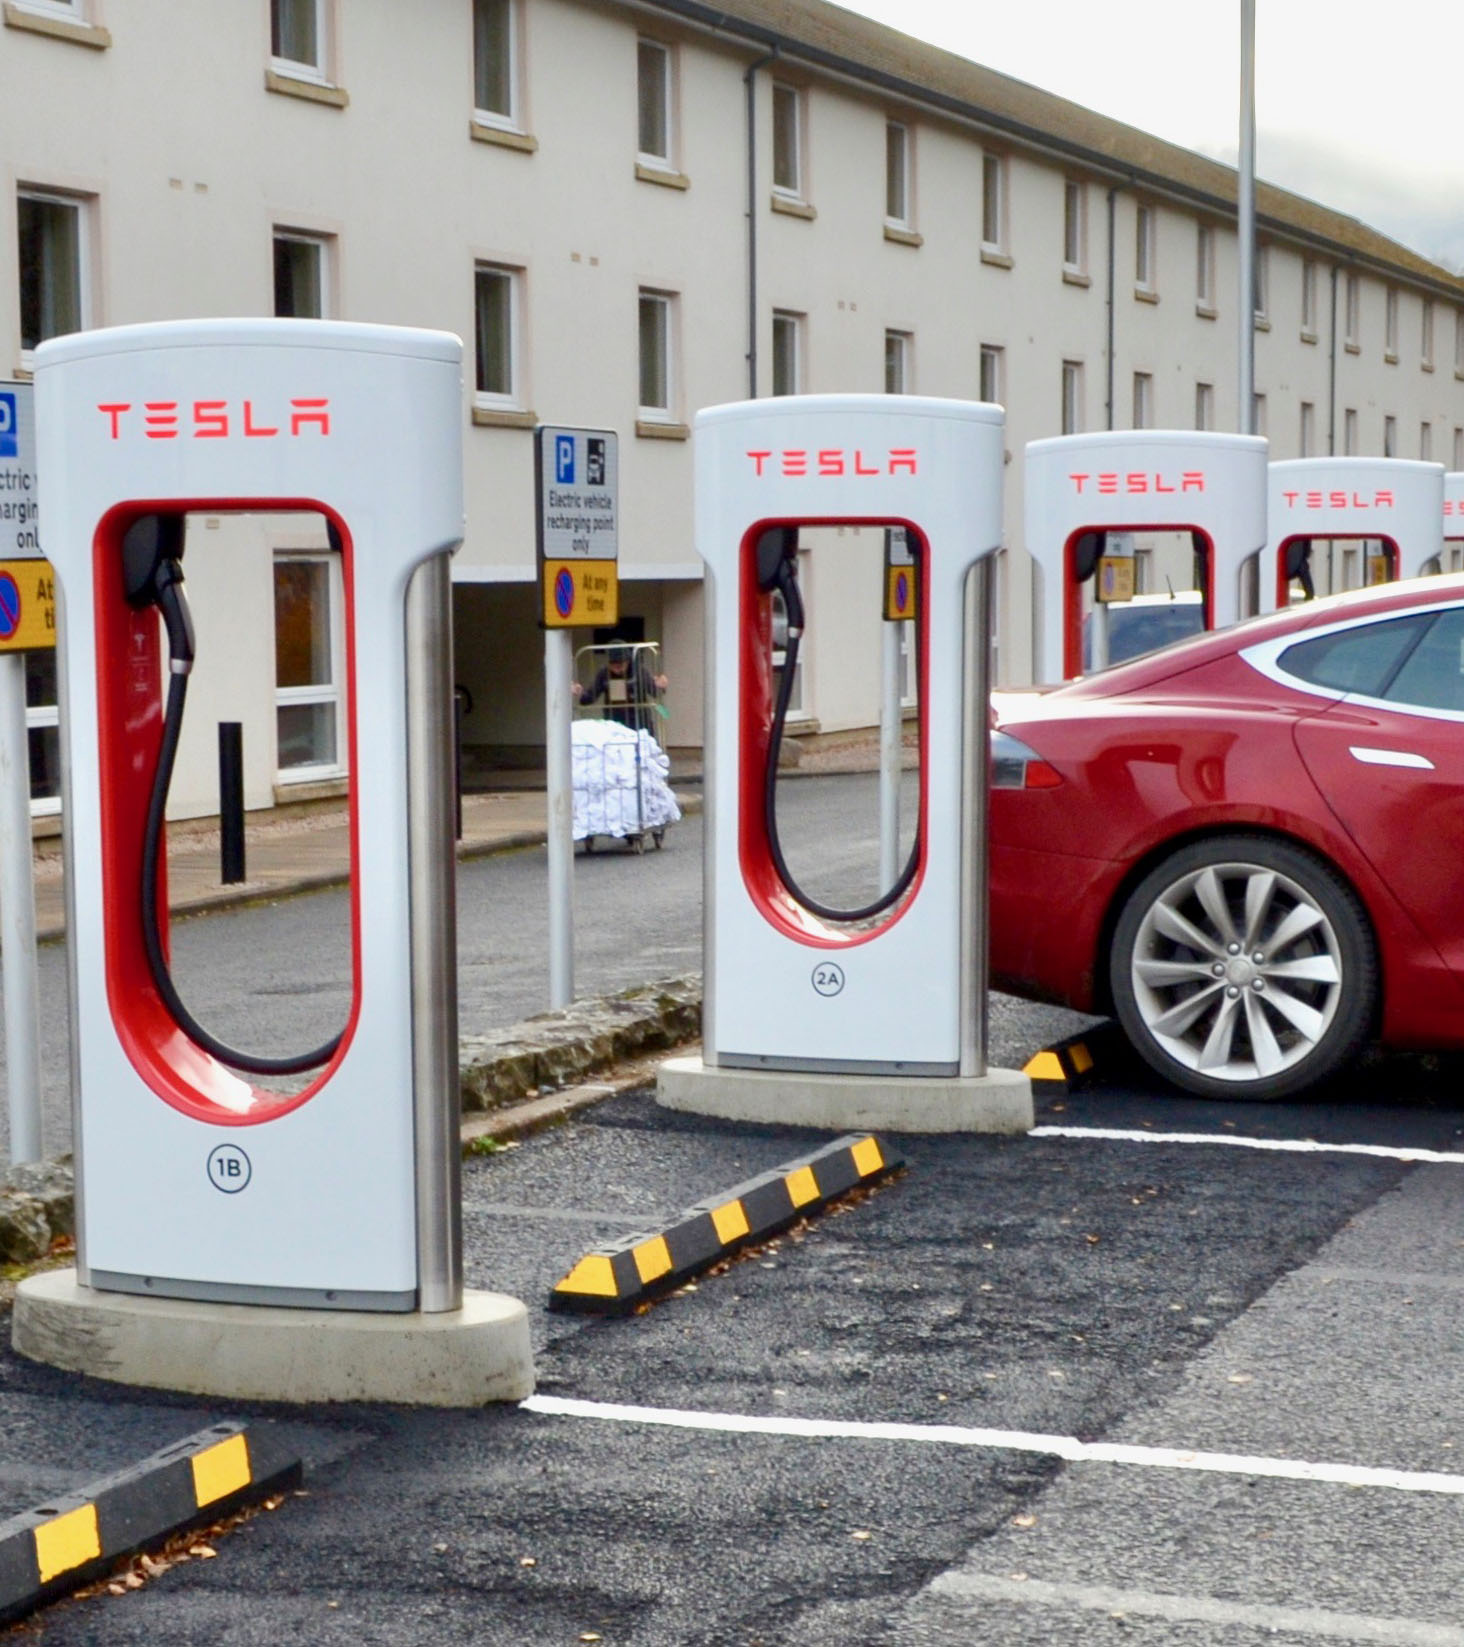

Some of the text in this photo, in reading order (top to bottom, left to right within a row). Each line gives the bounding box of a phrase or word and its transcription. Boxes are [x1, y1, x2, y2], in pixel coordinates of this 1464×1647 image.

[97, 398, 331, 440] TESLA
[560, 440, 572, 479] P
[746, 448, 917, 477] TESLA
[1069, 472, 1205, 494] TESLA
[549, 489, 612, 510] Electric vehicle
[1283, 490, 1394, 509] TESLA
[547, 513, 614, 533] recharging point
[17, 525, 43, 554] onl
[572, 535, 590, 555] only
[37, 578, 54, 601] At
[583, 574, 608, 594] At any
[587, 595, 604, 611] time
[817, 971, 840, 985] 2A
[216, 1158, 241, 1177] 1B
